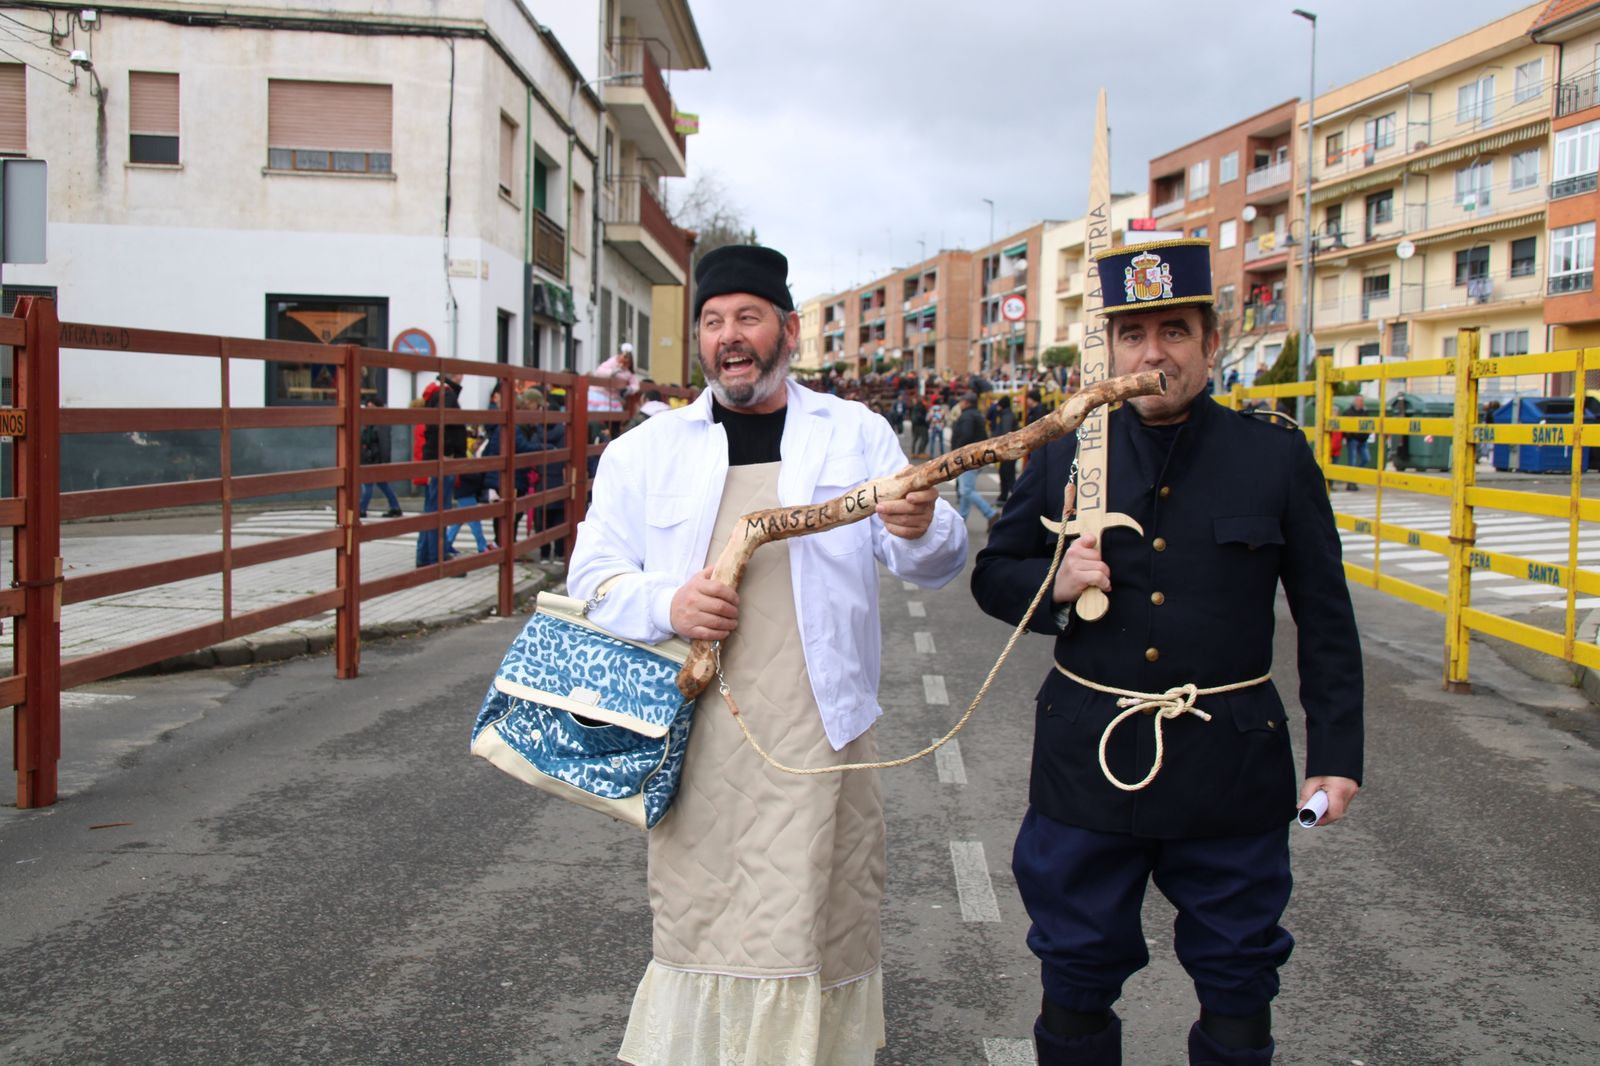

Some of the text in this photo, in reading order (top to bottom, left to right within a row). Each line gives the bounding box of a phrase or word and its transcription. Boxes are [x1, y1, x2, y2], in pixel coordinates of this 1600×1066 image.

[1084, 319, 1106, 349] DE
[0, 415, 23, 434] NOS
[1532, 426, 1564, 443] SANTA
[1079, 466, 1102, 512] LOS
[744, 504, 832, 541] MAUSER
[1528, 562, 1560, 585] SANTA
